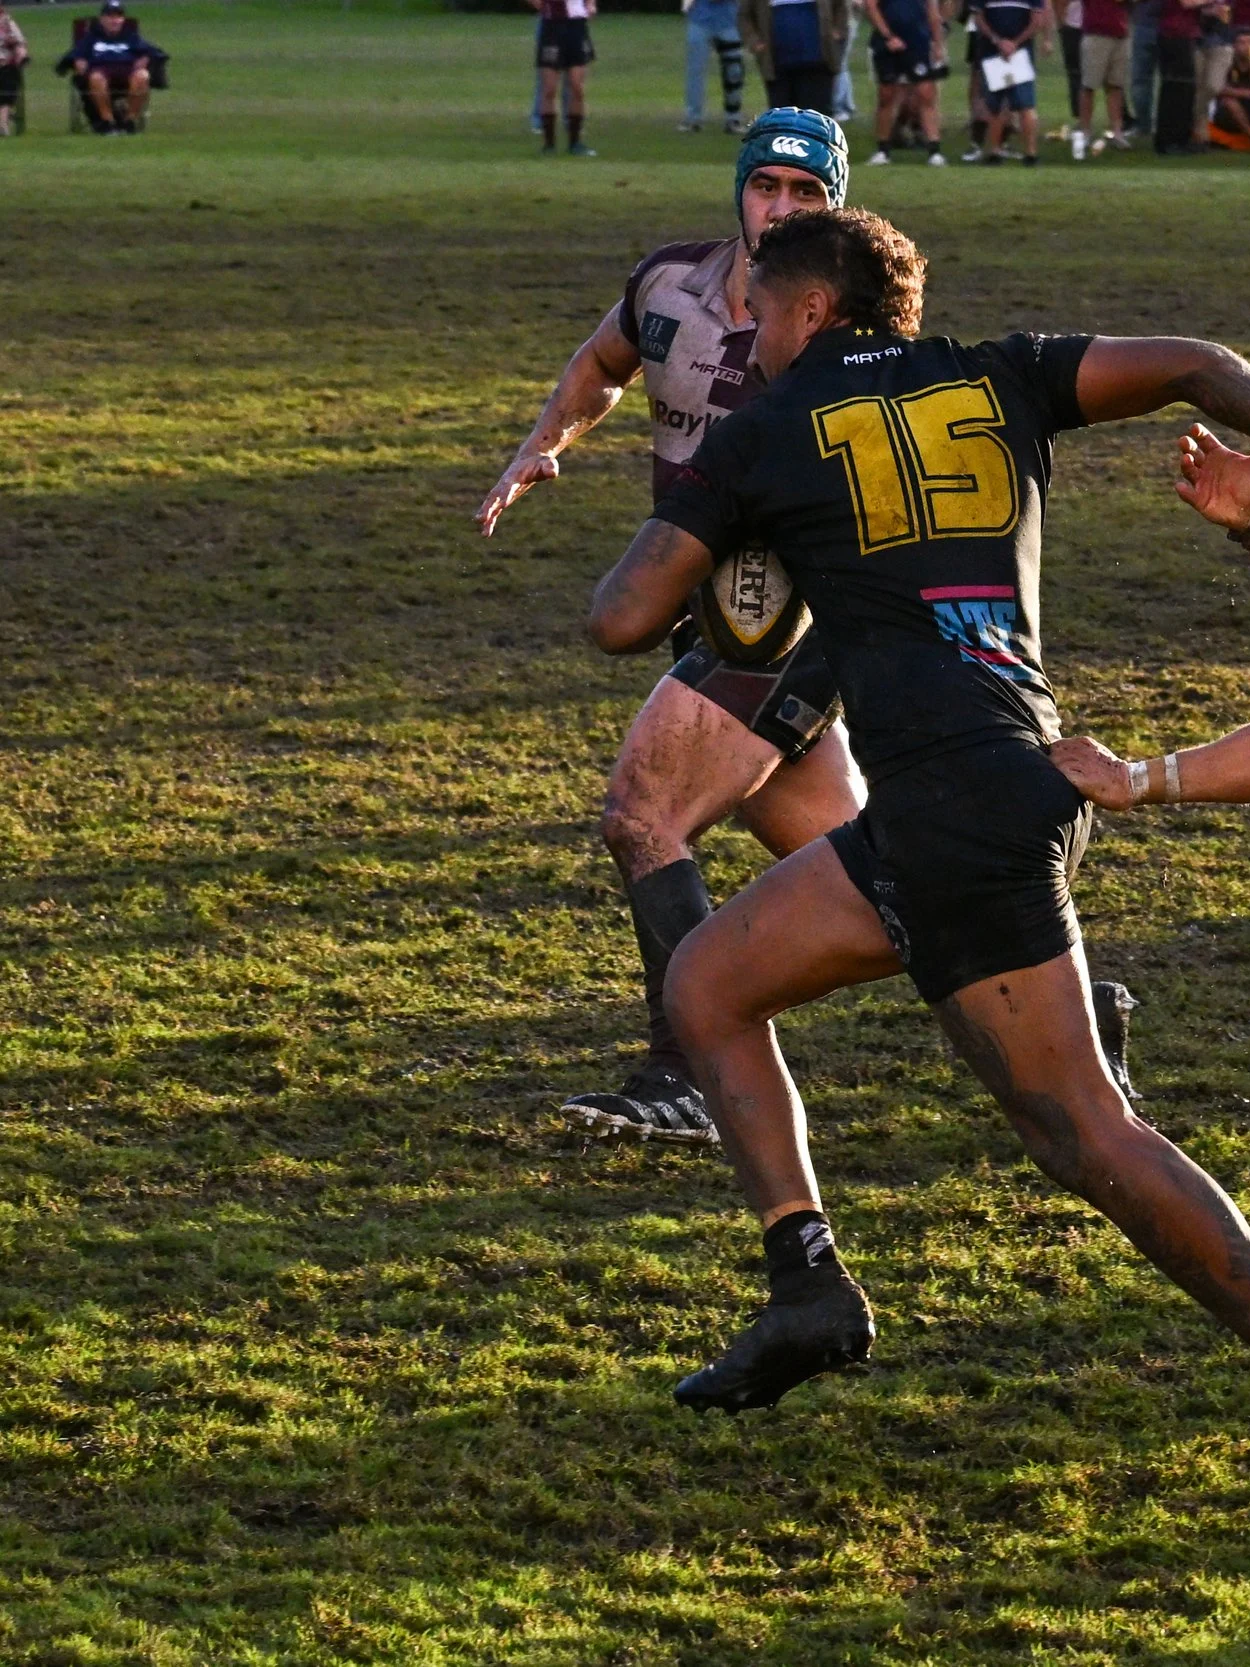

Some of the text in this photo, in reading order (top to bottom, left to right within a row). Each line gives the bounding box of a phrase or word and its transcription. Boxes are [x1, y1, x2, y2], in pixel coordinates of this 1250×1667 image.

[689, 360, 744, 384] MATAI
[843, 346, 903, 366] MATAI
[810, 375, 1020, 556] 15
[738, 547, 767, 620] ERT
